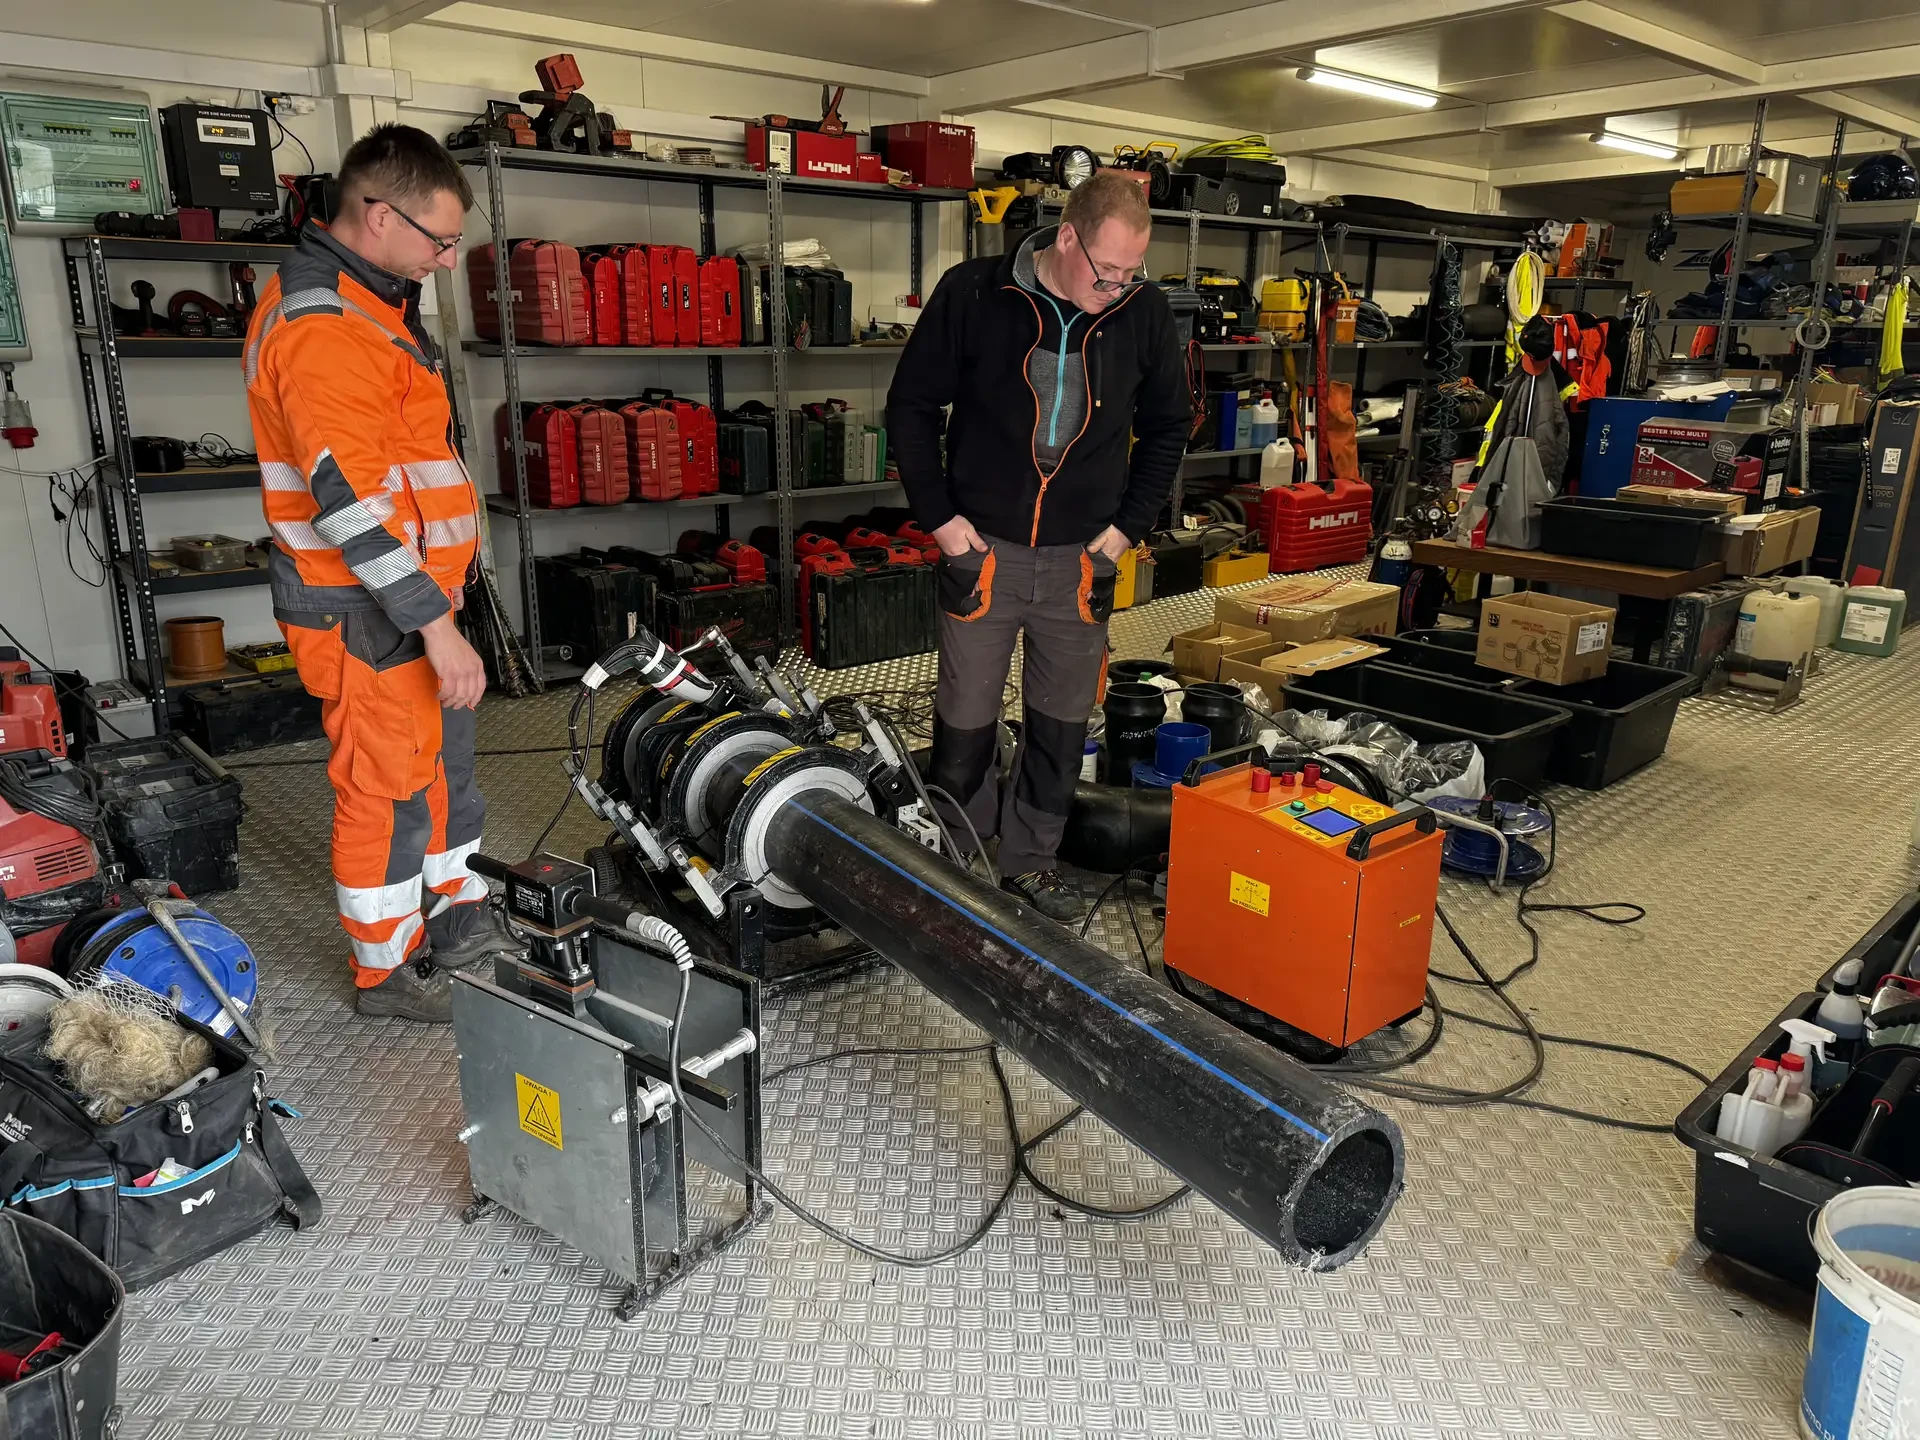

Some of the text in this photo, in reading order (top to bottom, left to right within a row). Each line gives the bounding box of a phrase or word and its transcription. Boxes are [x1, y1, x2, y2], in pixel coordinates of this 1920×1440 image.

[938, 126, 967, 137] HILTI
[808, 160, 851, 174] HILTI
[1642, 427, 1668, 436] BESTER
[1669, 429, 1686, 437] 190C
[1309, 511, 1358, 530] HILTI
[523, 1079, 548, 1095] UWAGA
[4, 1112, 33, 1135] MAC
